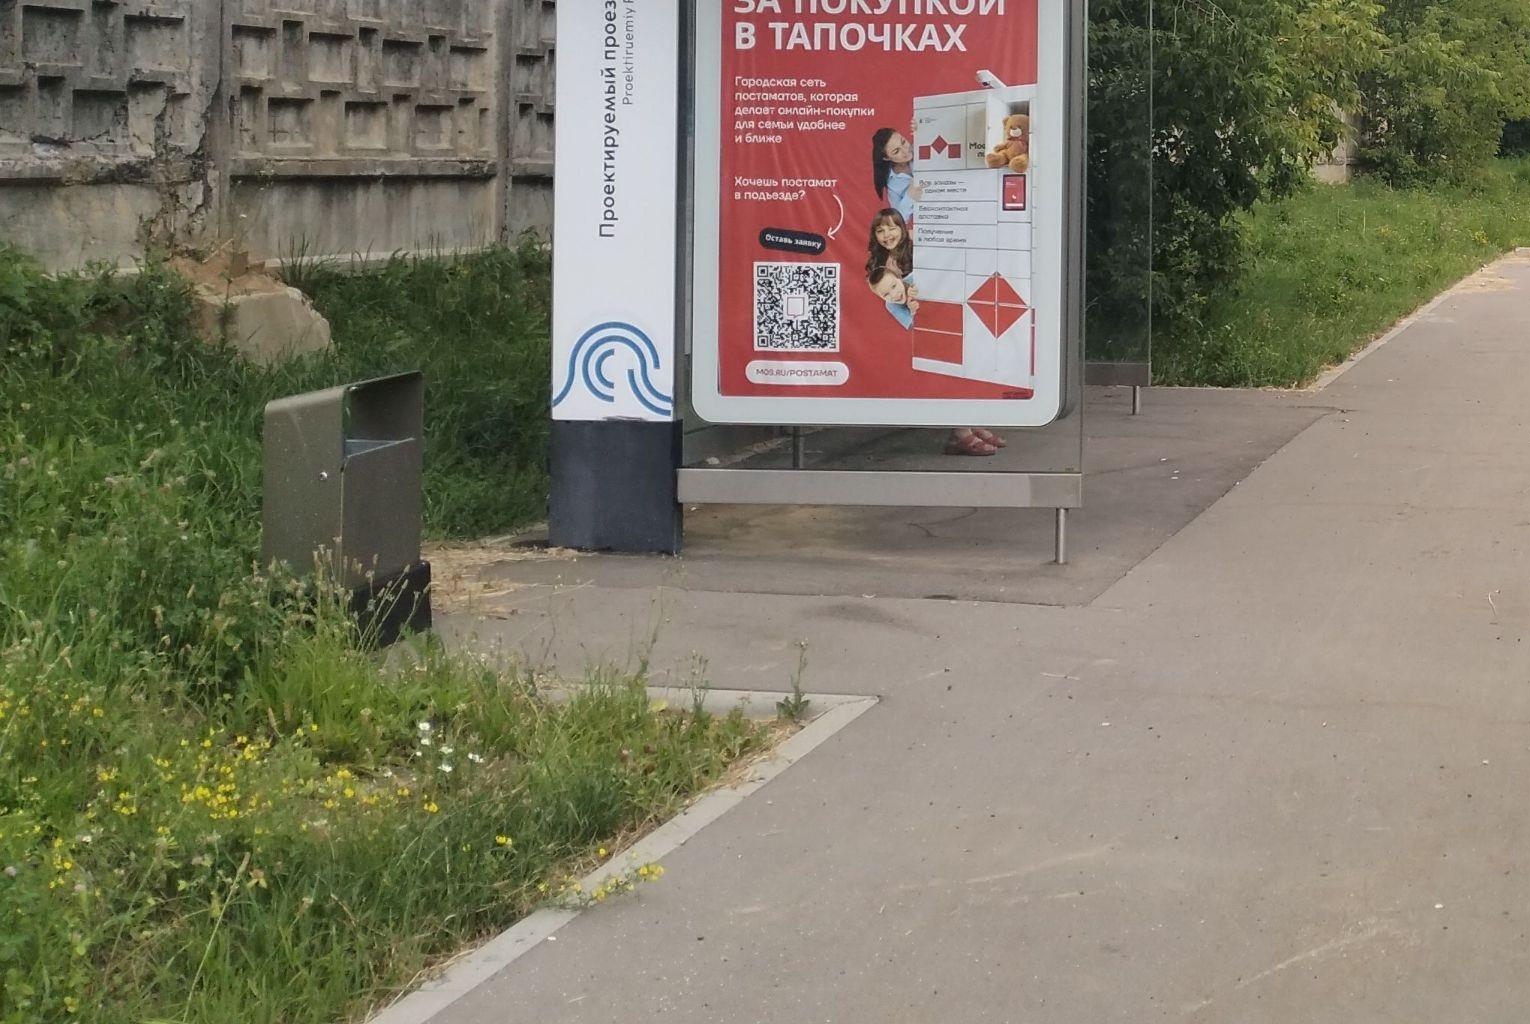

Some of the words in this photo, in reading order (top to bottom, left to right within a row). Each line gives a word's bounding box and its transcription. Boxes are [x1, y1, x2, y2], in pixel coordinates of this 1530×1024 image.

[735, 23, 756, 50] В
[768, 22, 967, 52] ТАПОЧКАХ
[623, 6, 636, 105] Proektiruemiy
[735, 77, 797, 89] Городская
[800, 79, 826, 88] сеть
[735, 92, 807, 103] постаматов,
[810, 92, 858, 103] которая
[735, 107, 775, 118] делает
[778, 105, 875, 118] онлайн-покупки
[735, 120, 755, 130] для
[757, 120, 794, 129] семьи
[797, 119, 846, 132] удобнее
[735, 135, 742, 143] и
[745, 132, 782, 144] ближе
[600, 67, 620, 238] Проектируемый
[734, 176, 778, 187] Хочешь
[781, 178, 837, 188] постамат
[734, 192, 742, 200] в
[765, 232, 793, 244] Оставь
[795, 238, 822, 249] заявку
